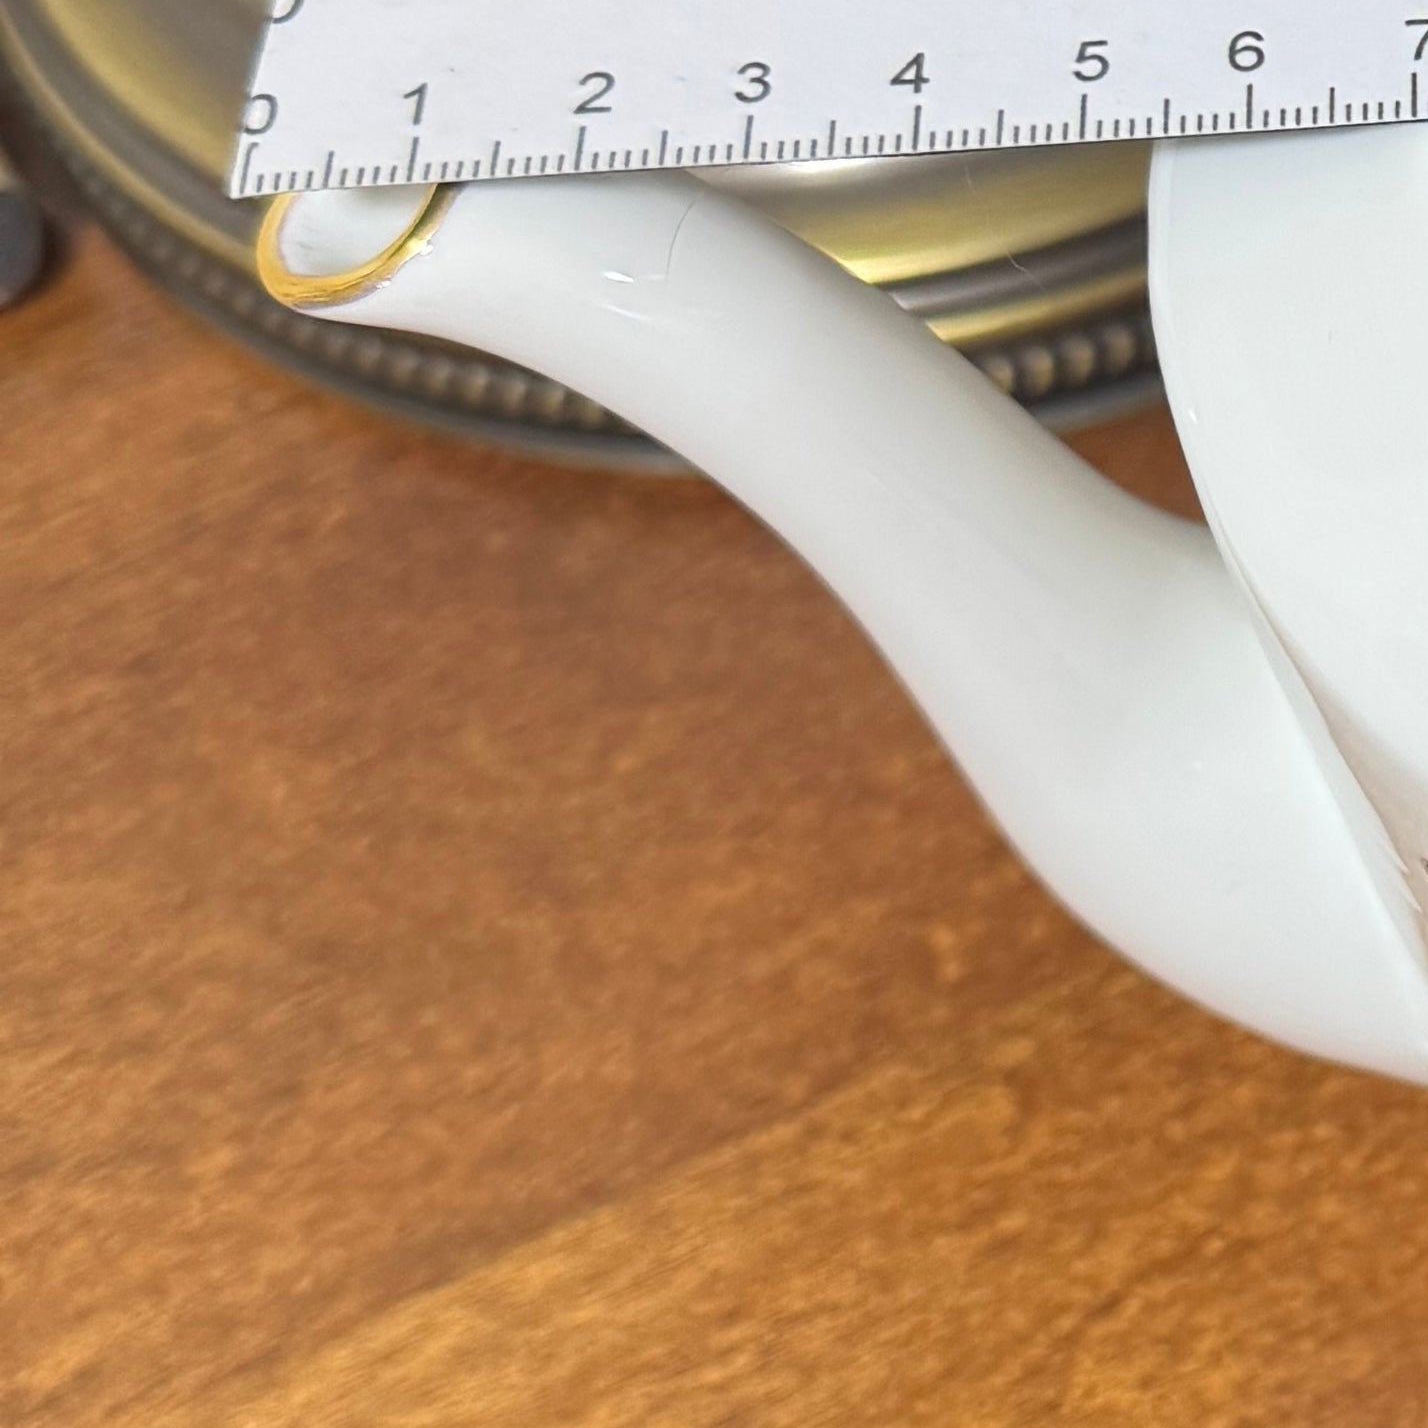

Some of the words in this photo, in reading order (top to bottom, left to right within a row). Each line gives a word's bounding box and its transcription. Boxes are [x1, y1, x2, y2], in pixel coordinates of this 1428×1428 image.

[242, 92, 280, 136] 0
[402, 82, 428, 126] 1
[572, 71, 616, 115] 2
[733, 61, 772, 104] 3
[889, 52, 931, 95] 4
[1071, 39, 1110, 83] 5
[1227, 30, 1266, 73] 6
